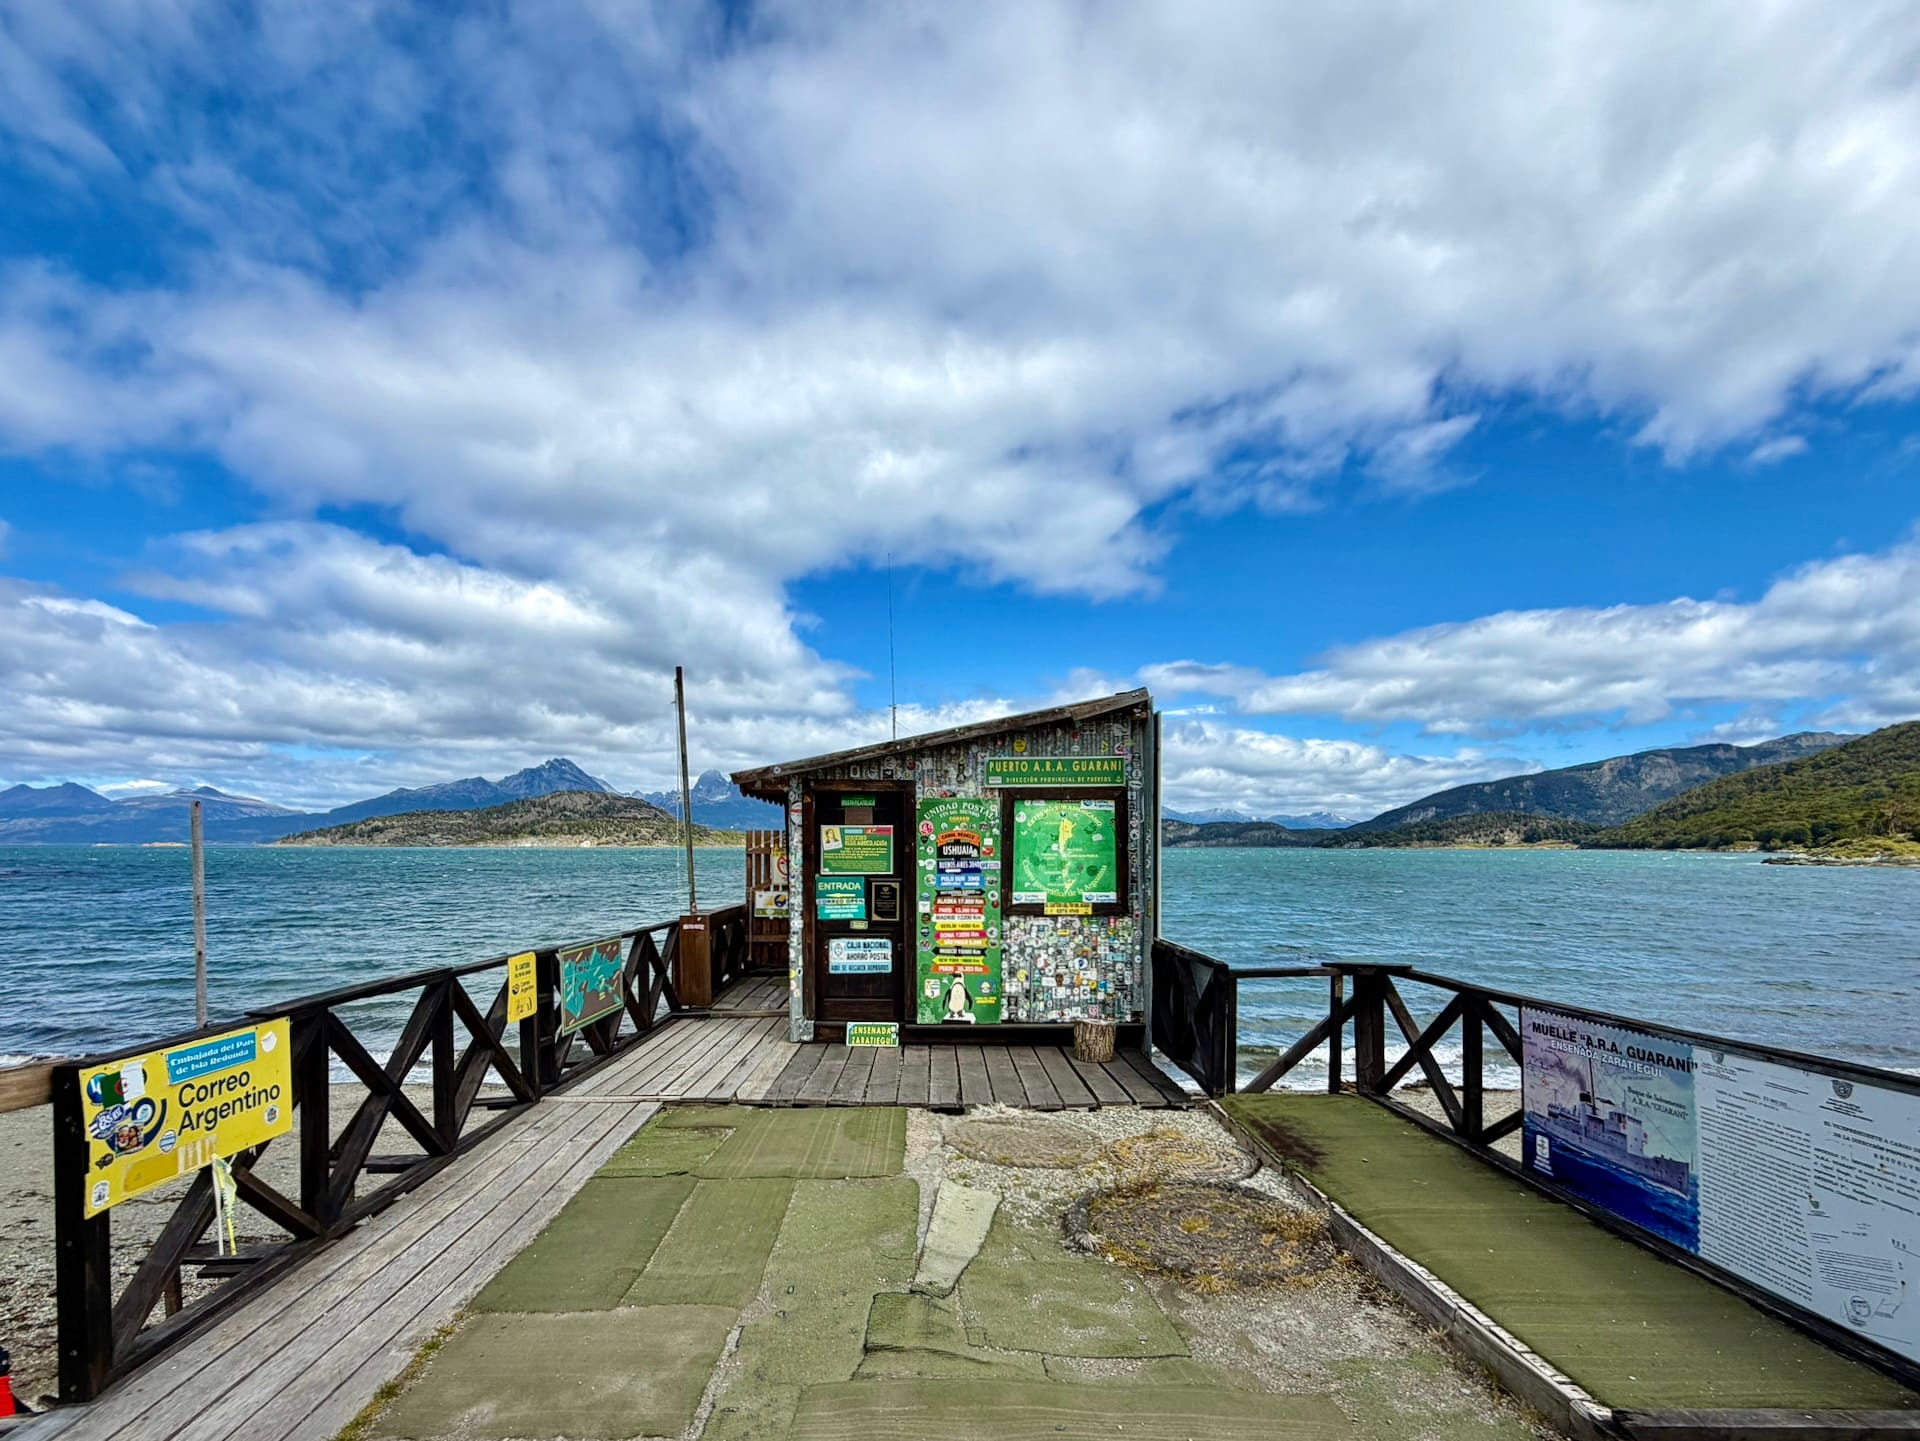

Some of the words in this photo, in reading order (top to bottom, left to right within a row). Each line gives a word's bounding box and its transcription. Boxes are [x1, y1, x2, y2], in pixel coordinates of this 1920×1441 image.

[989, 761, 1028, 772] PUERTO
[1033, 761, 1067, 772] A.R.A.
[1072, 761, 1121, 772] GUARANI
[924, 802, 958, 820] UNIDAD
[962, 802, 996, 820] POSTAL
[942, 845, 973, 856] USHUAIA
[818, 882, 861, 891] ENTRADA
[863, 941, 889, 949] NACIONAL
[846, 952, 868, 961] AHORRO
[869, 952, 890, 961] POSTAL
[854, 1026, 892, 1035] ENSENADA
[1532, 1022, 1577, 1043] MUELLE
[851, 1036, 894, 1045] ZARATIEGUI
[170, 1048, 219, 1066] Embajada
[220, 1044, 235, 1053] del
[175, 1065, 189, 1075] de
[191, 1061, 208, 1071] Isla
[210, 1049, 249, 1065] Redonda
[1550, 1039, 1599, 1060] ENSENADA
[1601, 1053, 1662, 1078] ZARATIEGUI
[178, 1071, 250, 1108] Correo
[178, 1085, 281, 1136] Argentino
